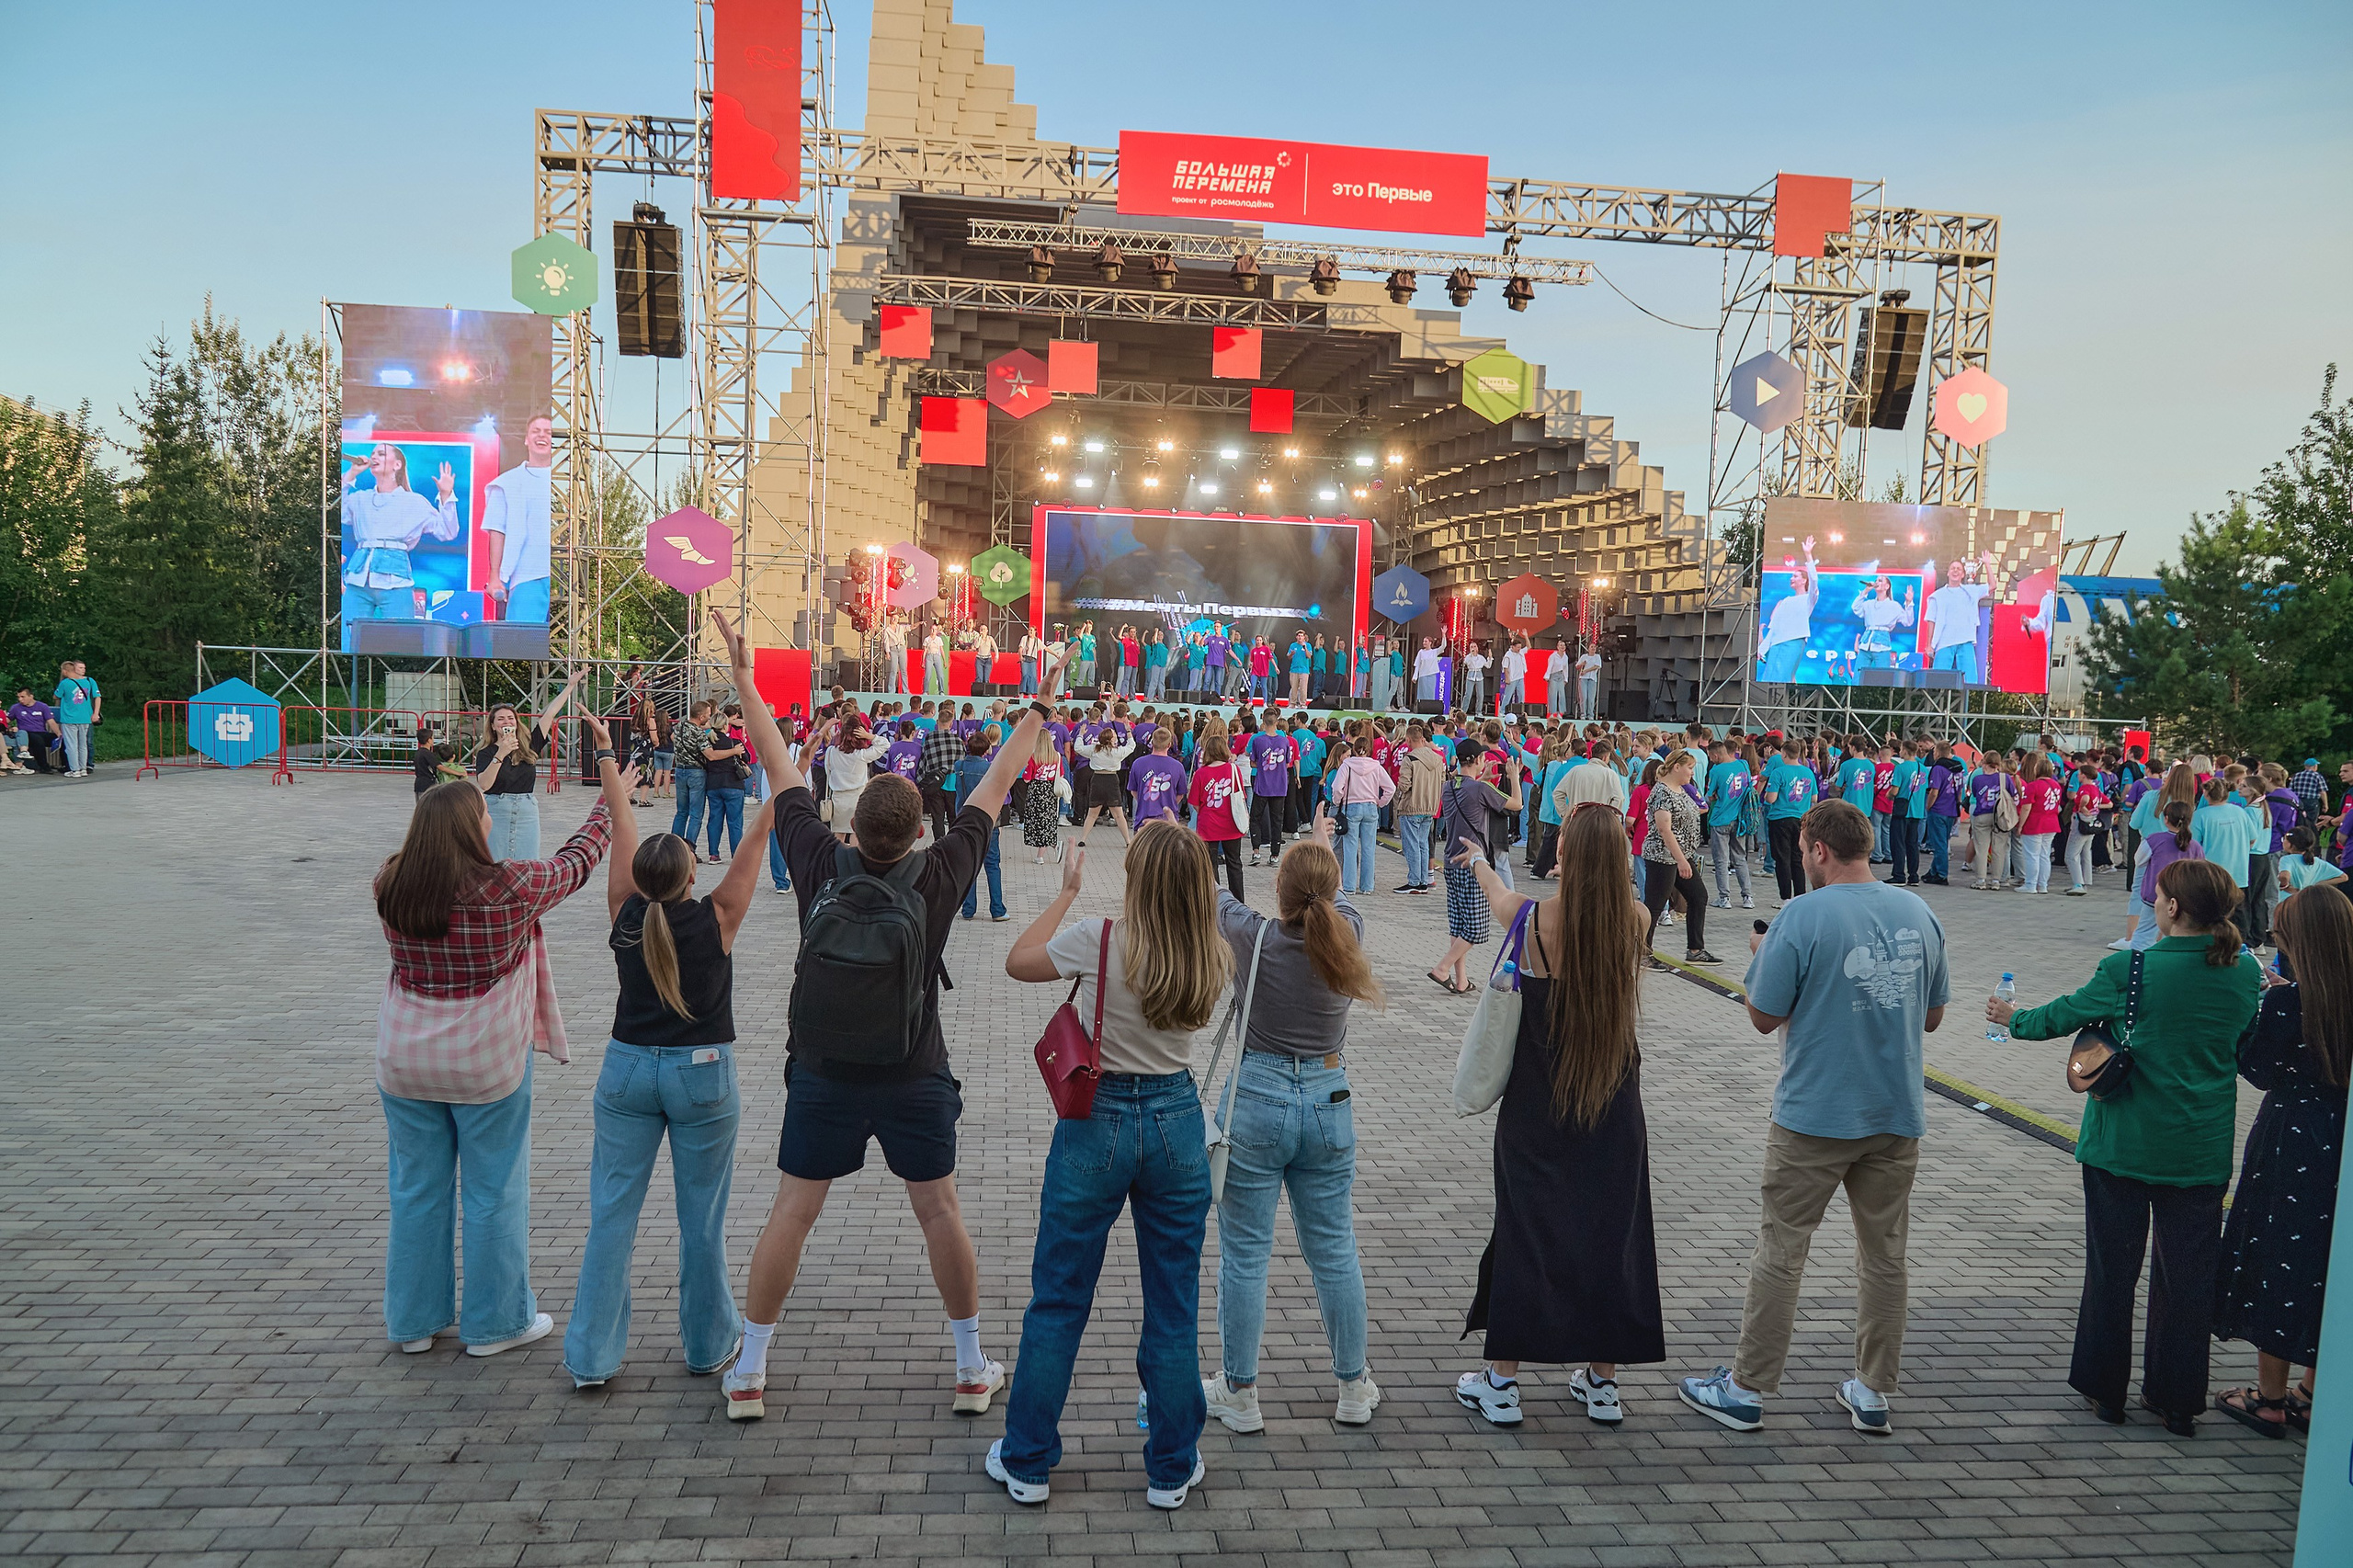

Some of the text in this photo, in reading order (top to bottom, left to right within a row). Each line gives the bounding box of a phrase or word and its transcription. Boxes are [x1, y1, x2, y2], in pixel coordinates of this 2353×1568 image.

[1176, 160, 1276, 180] БОЛЬШАЯ
[1172, 175, 1272, 194] ПЕРЕМЕНА
[1332, 182, 1433, 204] это Первые
[1172, 196, 1197, 204] проект
[1211, 198, 1275, 209] росмолодёжь
